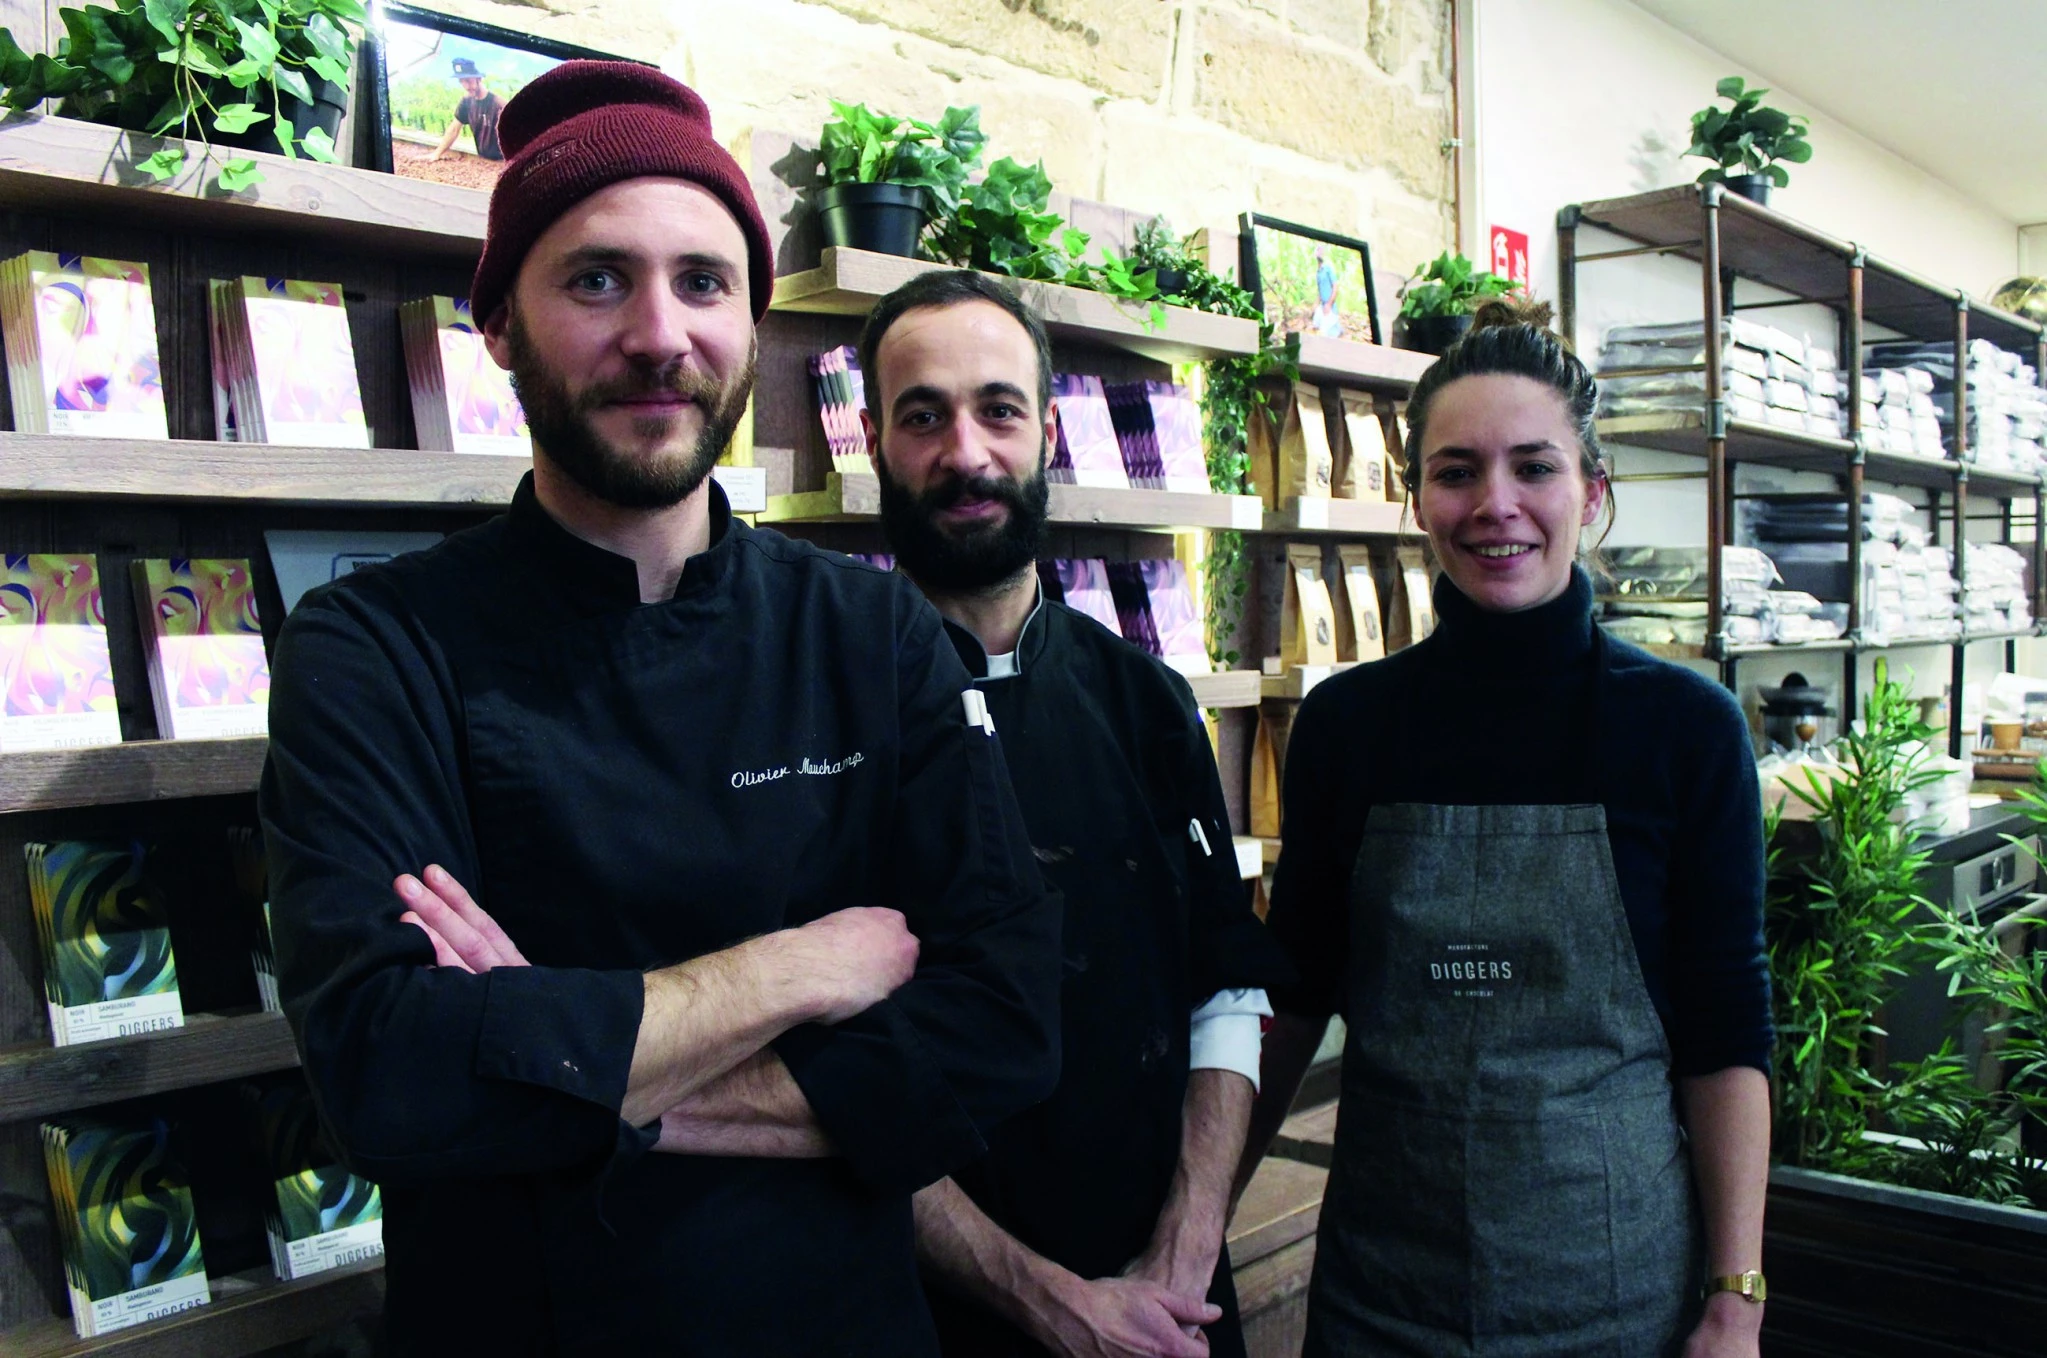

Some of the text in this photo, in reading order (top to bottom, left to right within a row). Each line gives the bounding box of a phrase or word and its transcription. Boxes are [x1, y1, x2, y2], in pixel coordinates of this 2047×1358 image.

[731, 752, 865, 788] Olivier Mauchamp
[1430, 961, 1512, 980] DIGGERS
[119, 1016, 175, 1036] DIGGERS
[335, 1243, 383, 1266] DIGGERS
